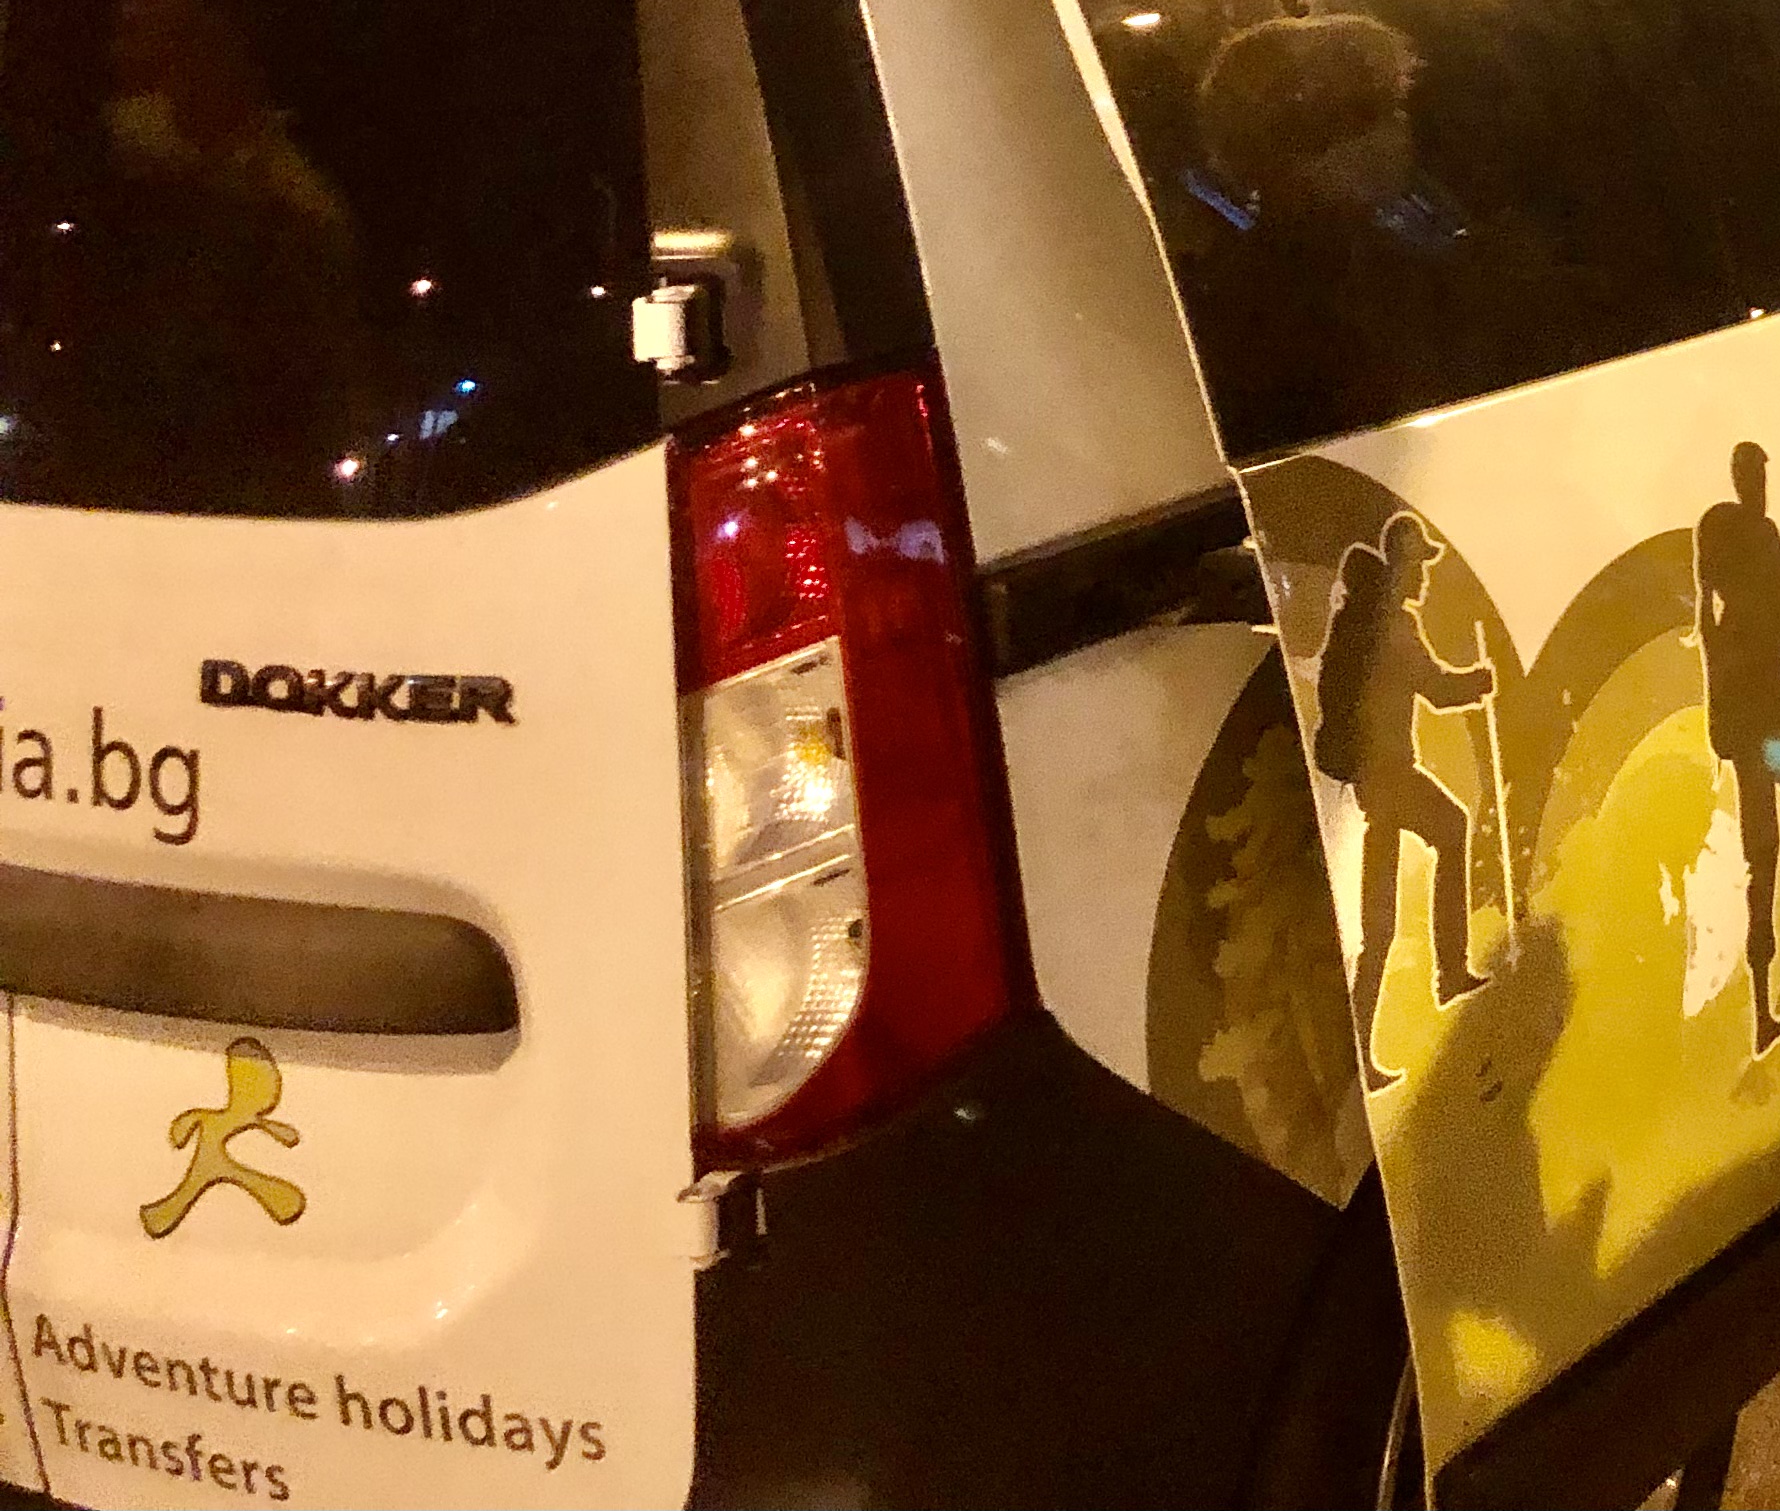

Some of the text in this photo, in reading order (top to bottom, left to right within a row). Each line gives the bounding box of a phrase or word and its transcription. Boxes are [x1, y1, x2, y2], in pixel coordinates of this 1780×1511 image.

[200, 659, 518, 726] DOKKER
[32, 1313, 608, 1470] Adventure holidays
[40, 1398, 291, 1502] Transfers
